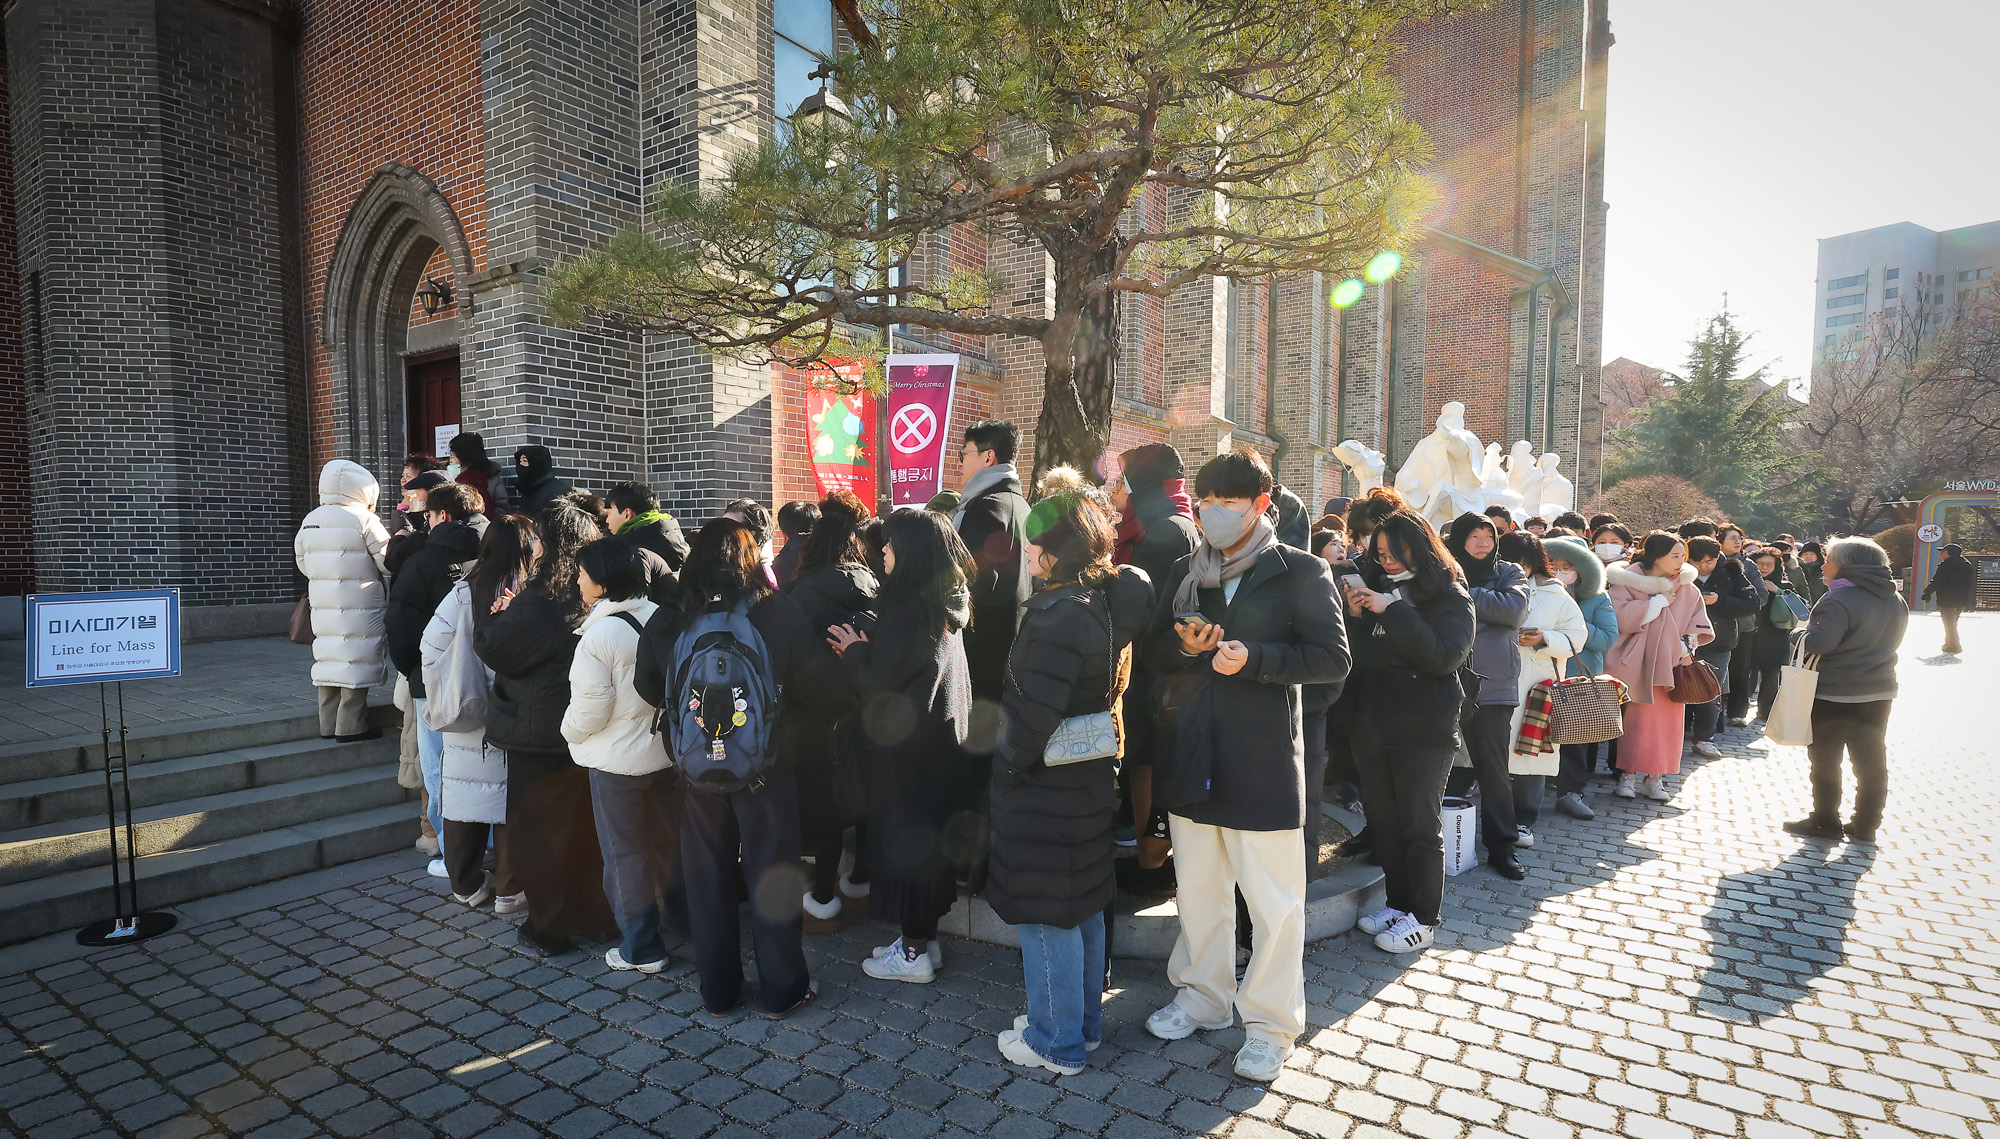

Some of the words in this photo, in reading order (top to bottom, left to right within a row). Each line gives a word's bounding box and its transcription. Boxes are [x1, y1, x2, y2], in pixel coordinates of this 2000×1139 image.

[892, 381, 913, 391] Merry
[913, 380, 946, 389] Christmas
[49, 615, 157, 634] 미사대기열
[51, 644, 84, 656] Line
[90, 642, 112, 654] for
[117, 640, 156, 652] Mass
